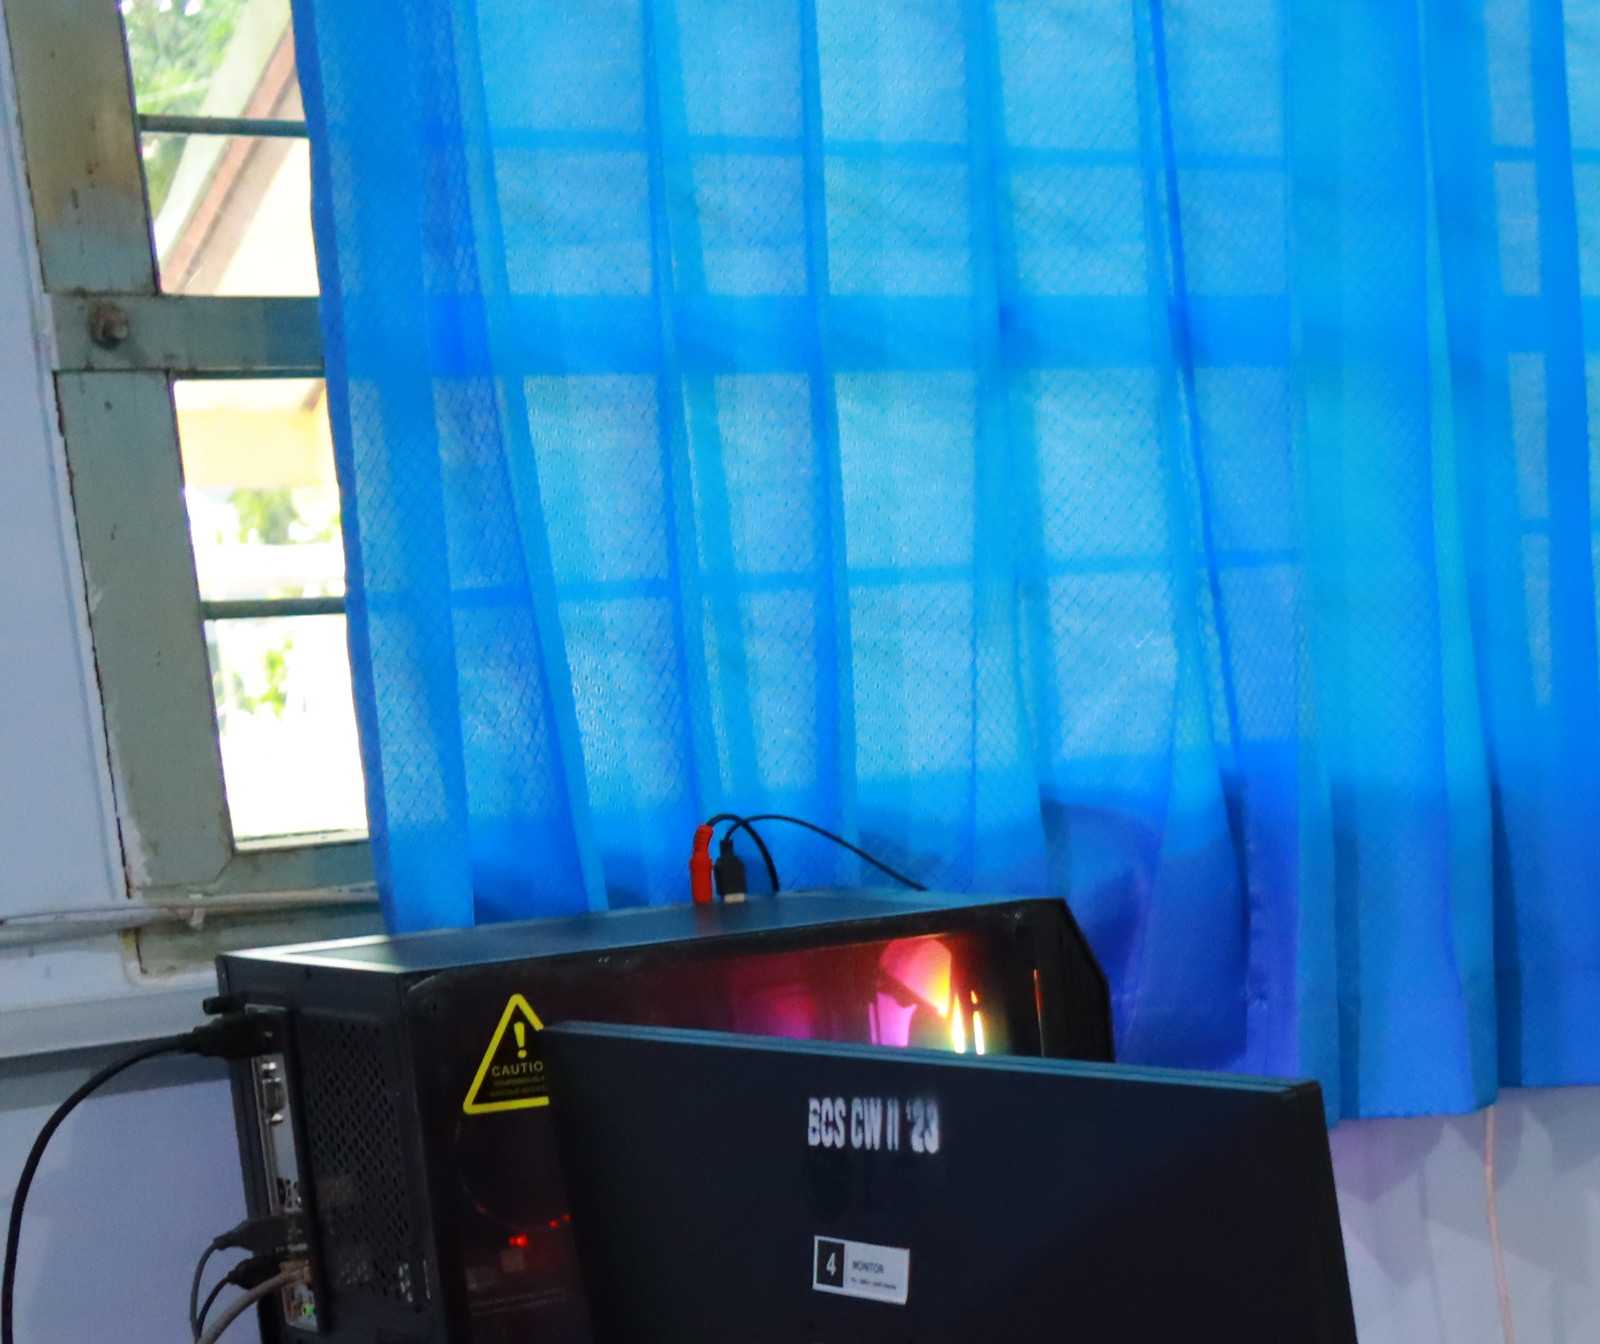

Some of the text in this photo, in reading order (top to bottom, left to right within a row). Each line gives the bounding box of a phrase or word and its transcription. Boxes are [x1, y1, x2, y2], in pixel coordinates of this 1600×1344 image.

[491, 1060, 545, 1077] CAUTIO
[808, 1096, 847, 1149] BCS
[850, 1097, 883, 1151] CW
[826, 1251, 837, 1277] 4
